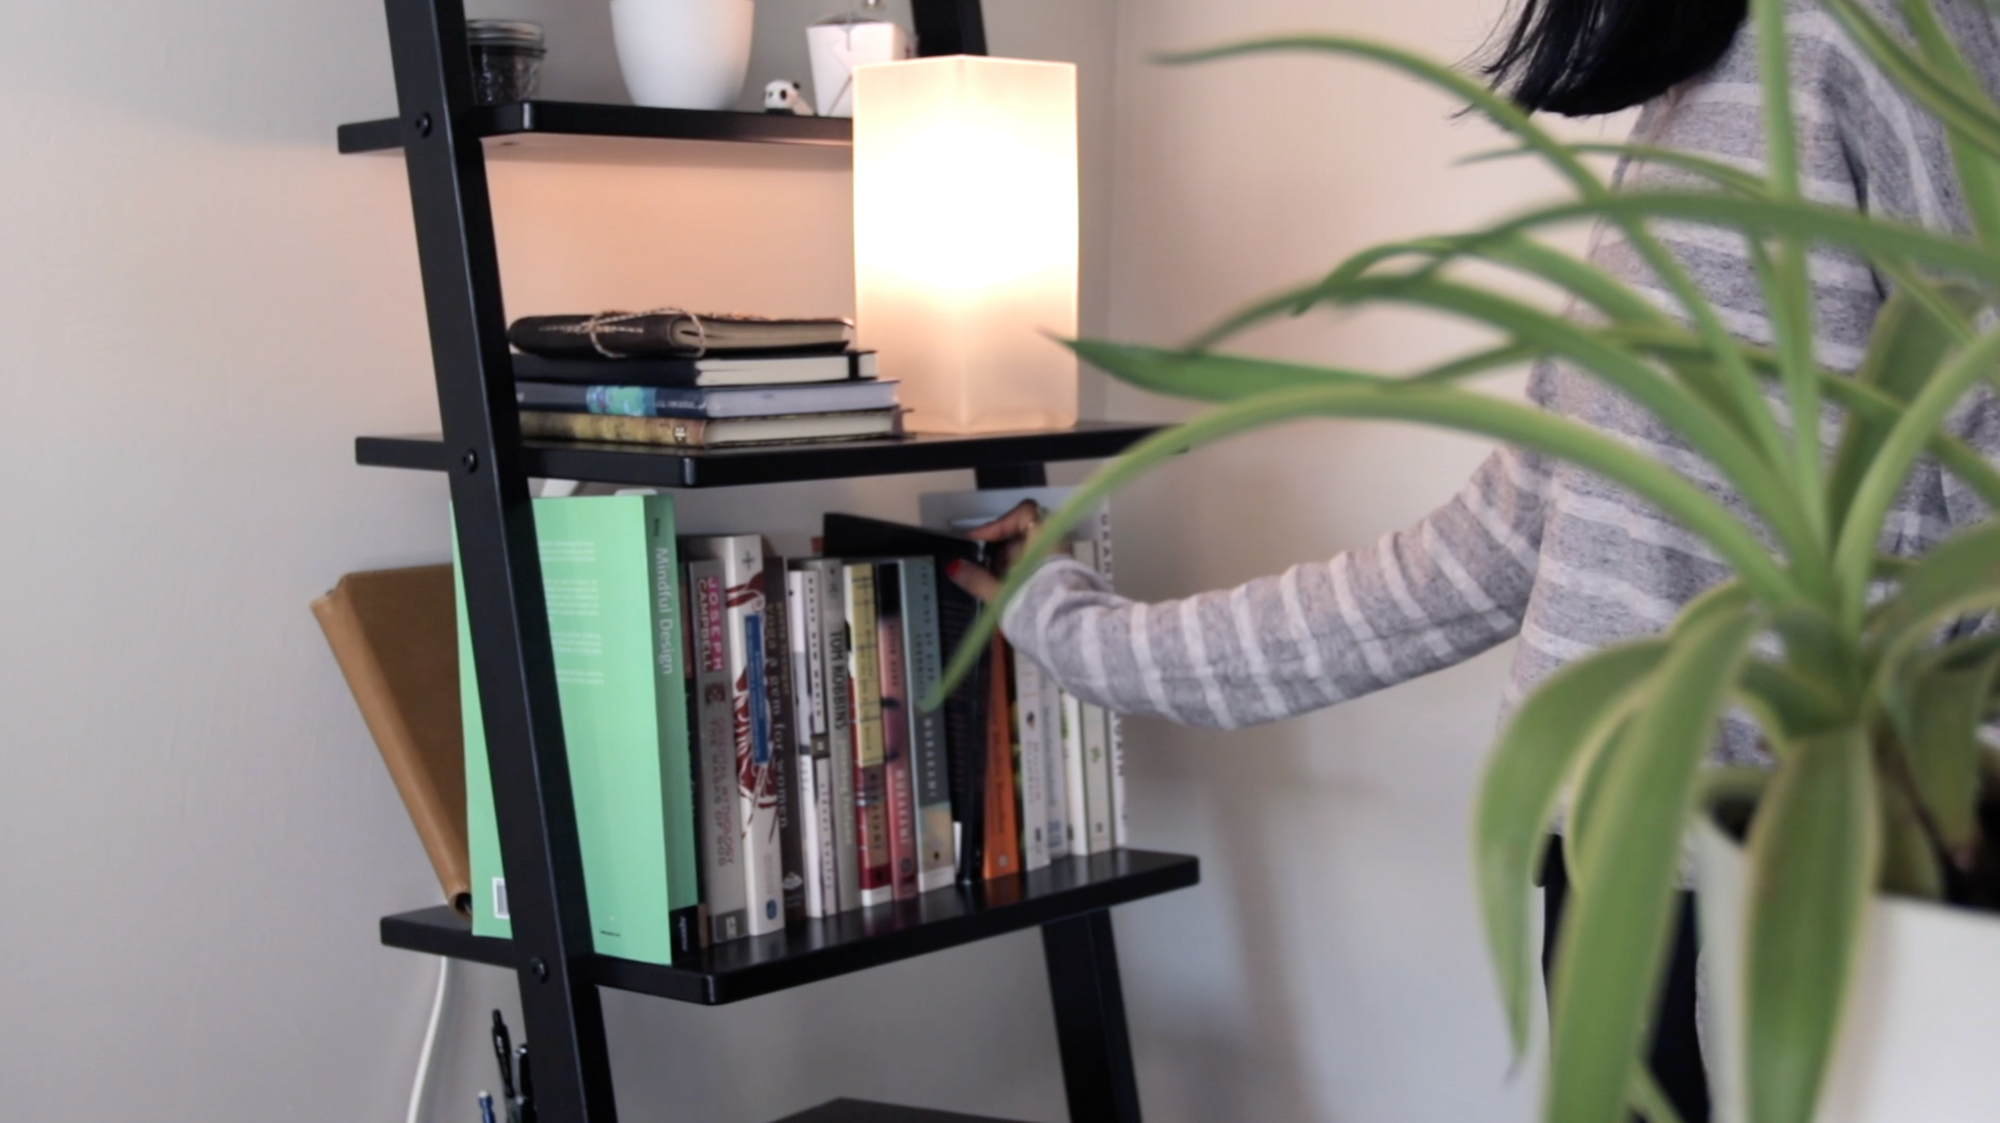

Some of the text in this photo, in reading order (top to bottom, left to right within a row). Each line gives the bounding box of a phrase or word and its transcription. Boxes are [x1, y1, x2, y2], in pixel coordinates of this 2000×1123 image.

[655, 548, 675, 674] Mindful Design
[698, 579, 712, 671] CAMPBELL
[708, 577, 723, 670] JOSEPH
[830, 630, 848, 730] TOM ROBBINS
[895, 769, 908, 845] MURAKAMI
